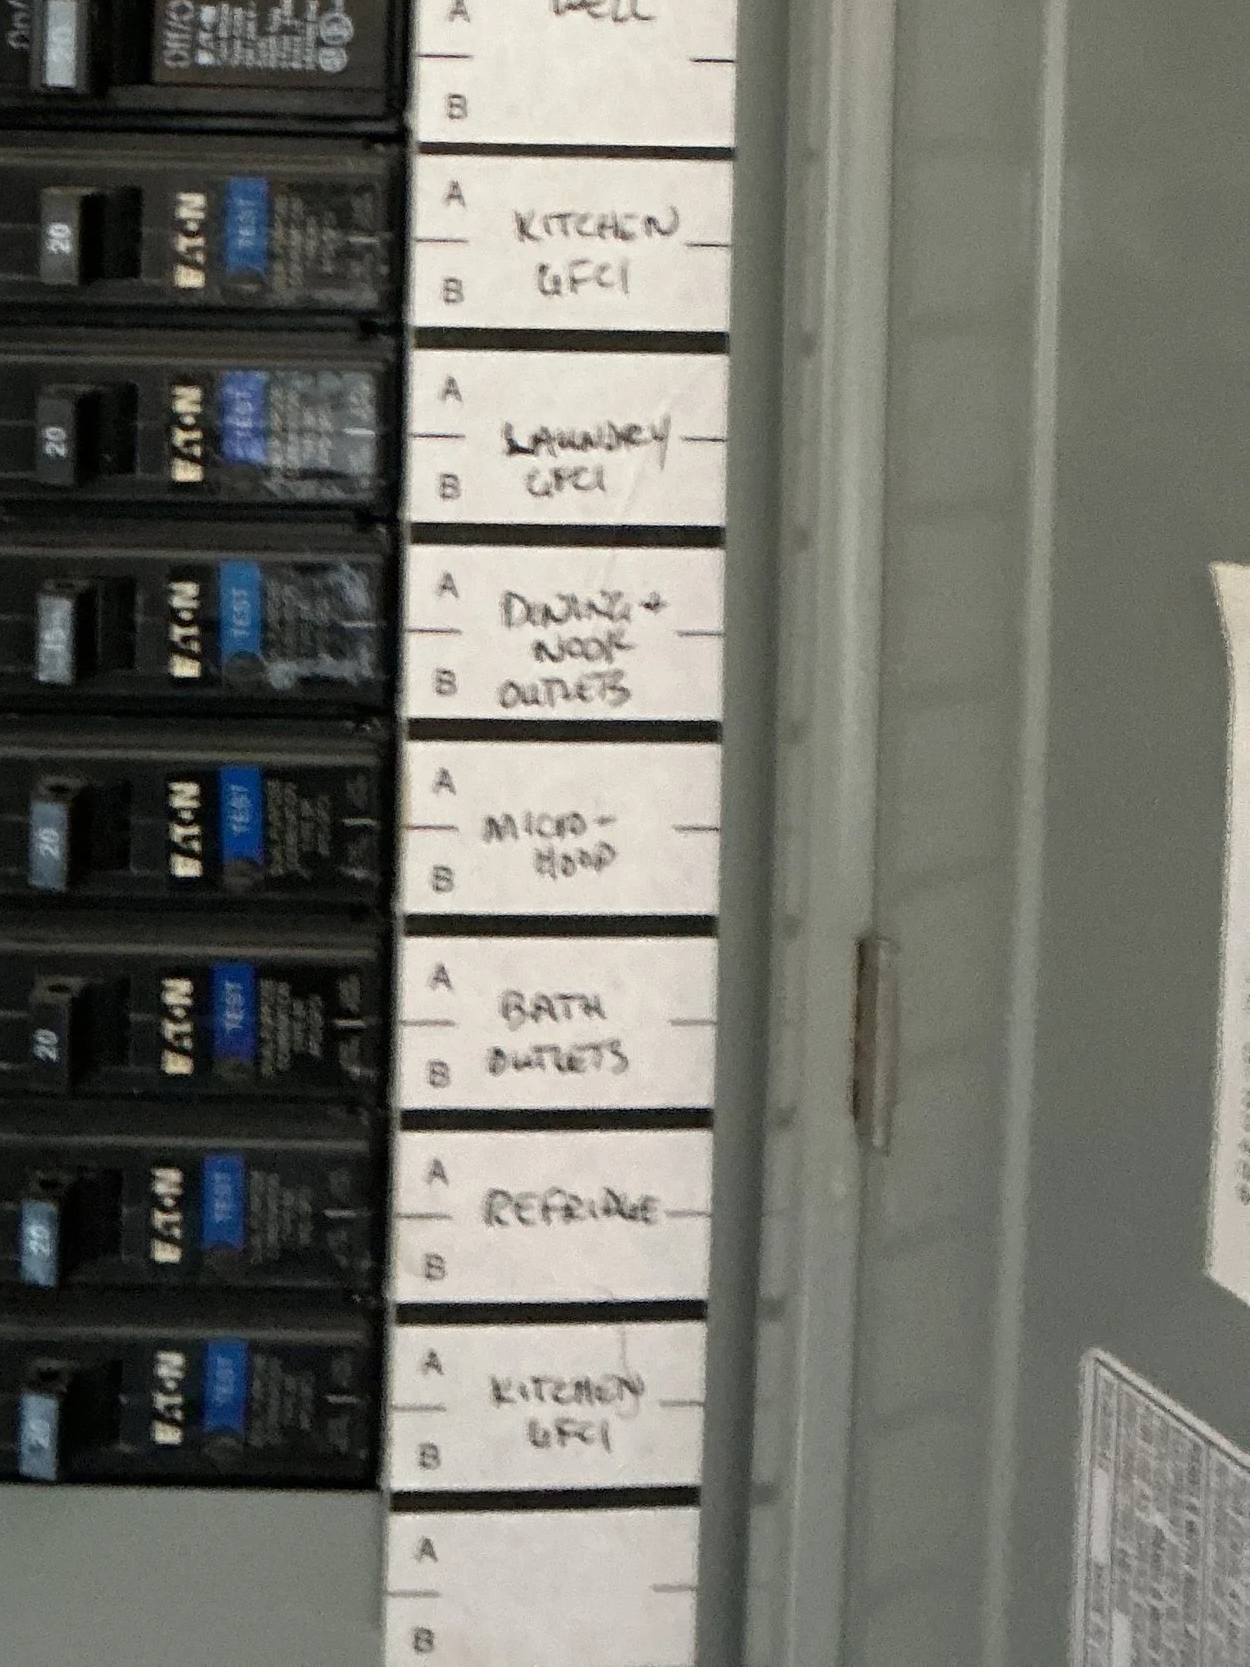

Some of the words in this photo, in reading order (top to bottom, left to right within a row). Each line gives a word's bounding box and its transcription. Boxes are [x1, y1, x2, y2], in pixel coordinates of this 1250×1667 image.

[445, 93, 468, 121] B
[47, 222, 72, 255] 20
[513, 205, 680, 243] KITCHEN
[537, 259, 632, 297] GFCI
[438, 375, 463, 403] A
[44, 426, 68, 458] 20
[438, 473, 461, 501] B
[532, 628, 635, 664] NOOK
[498, 669, 631, 709] OUTLETS
[432, 767, 456, 795] A
[429, 865, 455, 894] B
[500, 989, 607, 1032] BATH
[487, 1037, 629, 1077] OUTLETS
[425, 1157, 449, 1186] A
[419, 1252, 448, 1282] B
[490, 1372, 645, 1409] KITCHEN
[414, 1536, 438, 1563] A
[411, 1626, 435, 1655] B
